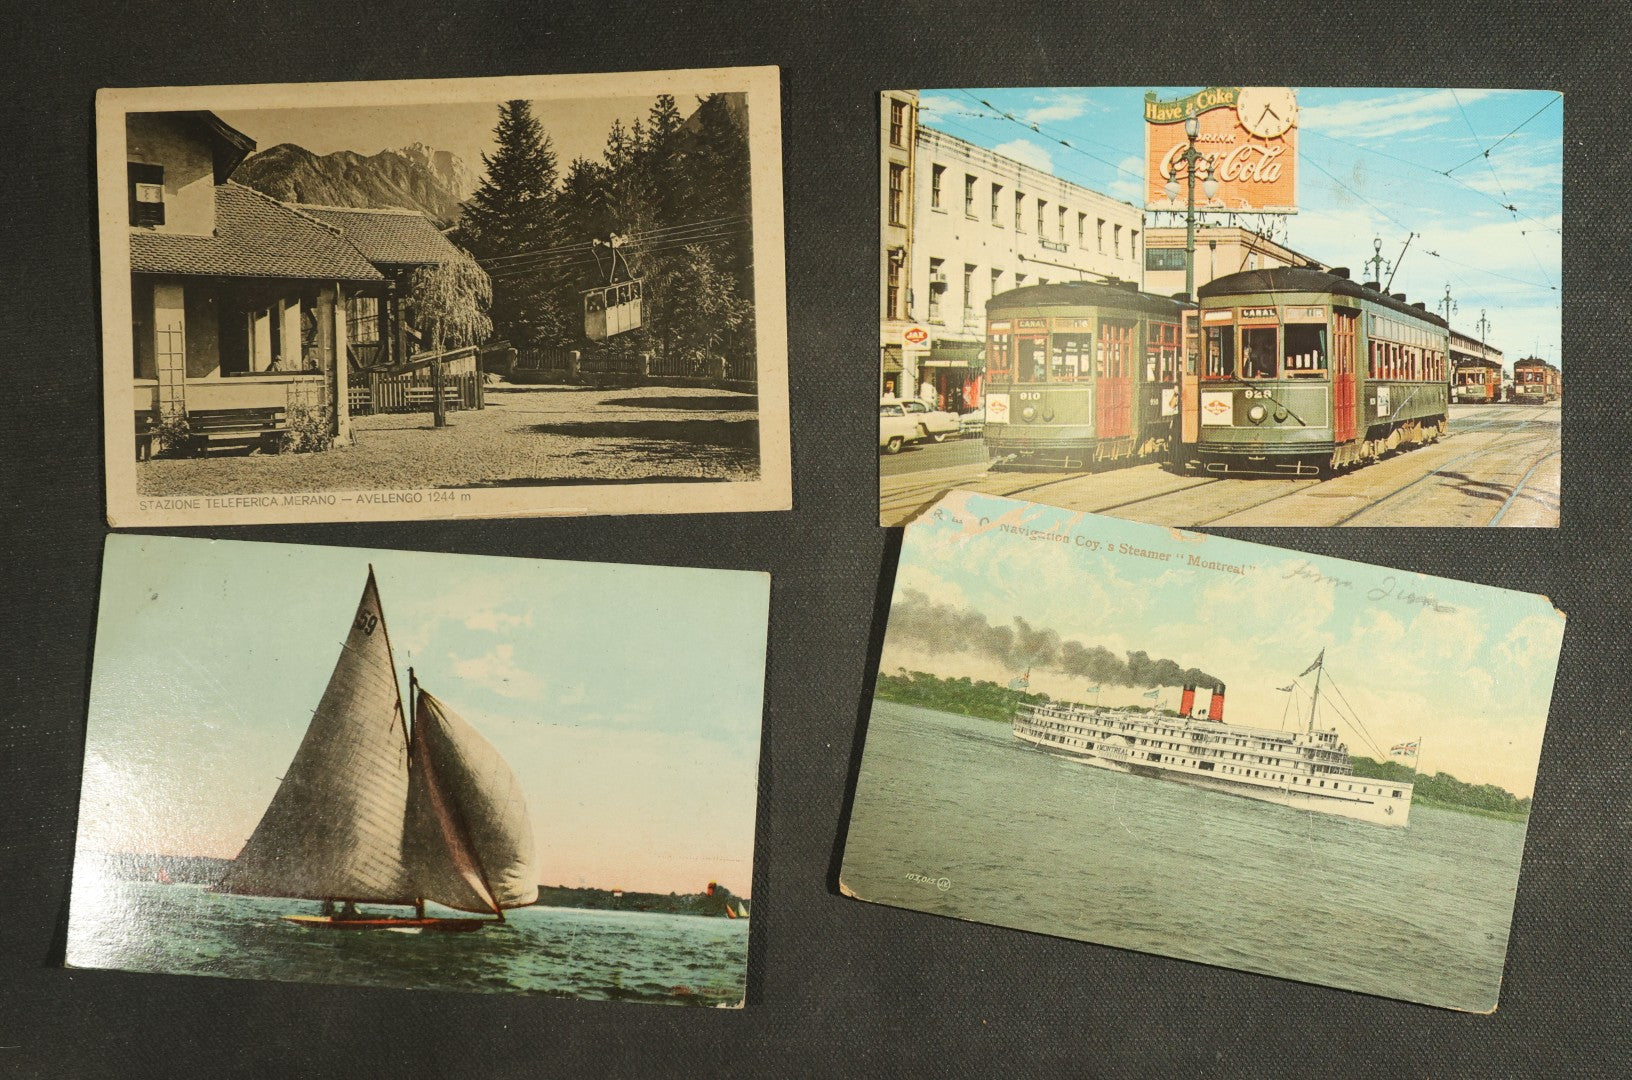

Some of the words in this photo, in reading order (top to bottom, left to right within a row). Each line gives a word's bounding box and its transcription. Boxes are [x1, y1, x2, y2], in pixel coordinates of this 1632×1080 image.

[1146, 102, 1182, 120] Have
[1196, 88, 1234, 109] Coke
[1243, 308, 1276, 317] CANAL
[1019, 320, 1046, 328] CANAL
[1019, 391, 1041, 401] 910
[139, 498, 201, 511] STAZIONE
[205, 496, 278, 509] TELEFERICA
[356, 492, 422, 504] AVELENGO
[427, 490, 455, 503] 1244
[460, 492, 471, 501] m
[1075, 534, 1103, 552] Coy.
[1118, 543, 1172, 562] Steamer
